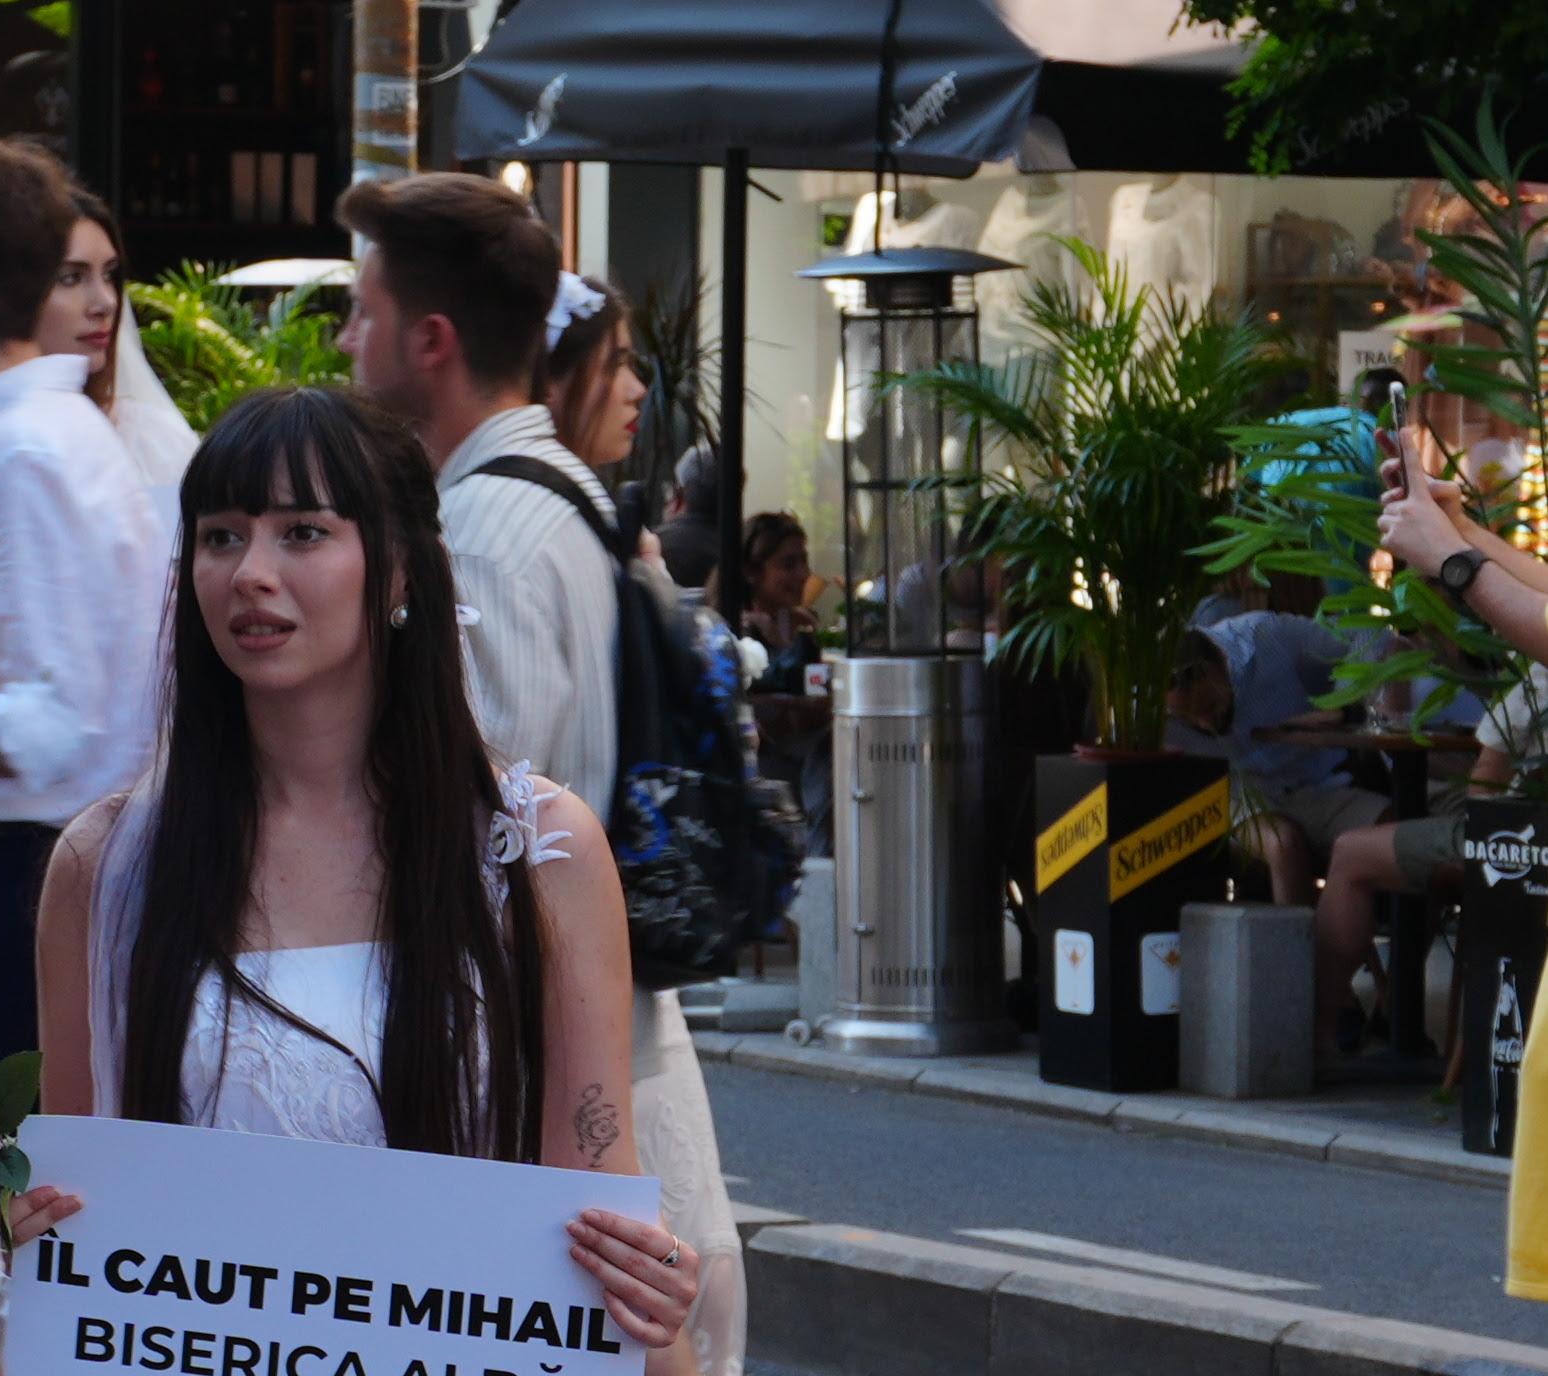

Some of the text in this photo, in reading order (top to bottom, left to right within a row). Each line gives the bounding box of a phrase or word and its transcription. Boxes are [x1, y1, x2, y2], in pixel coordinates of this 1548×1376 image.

[1114, 798, 1224, 882] Schweppes
[103, 1247, 279, 1310] CAUT
[290, 1270, 374, 1324] PE
[388, 1283, 622, 1354] MIHAIL
